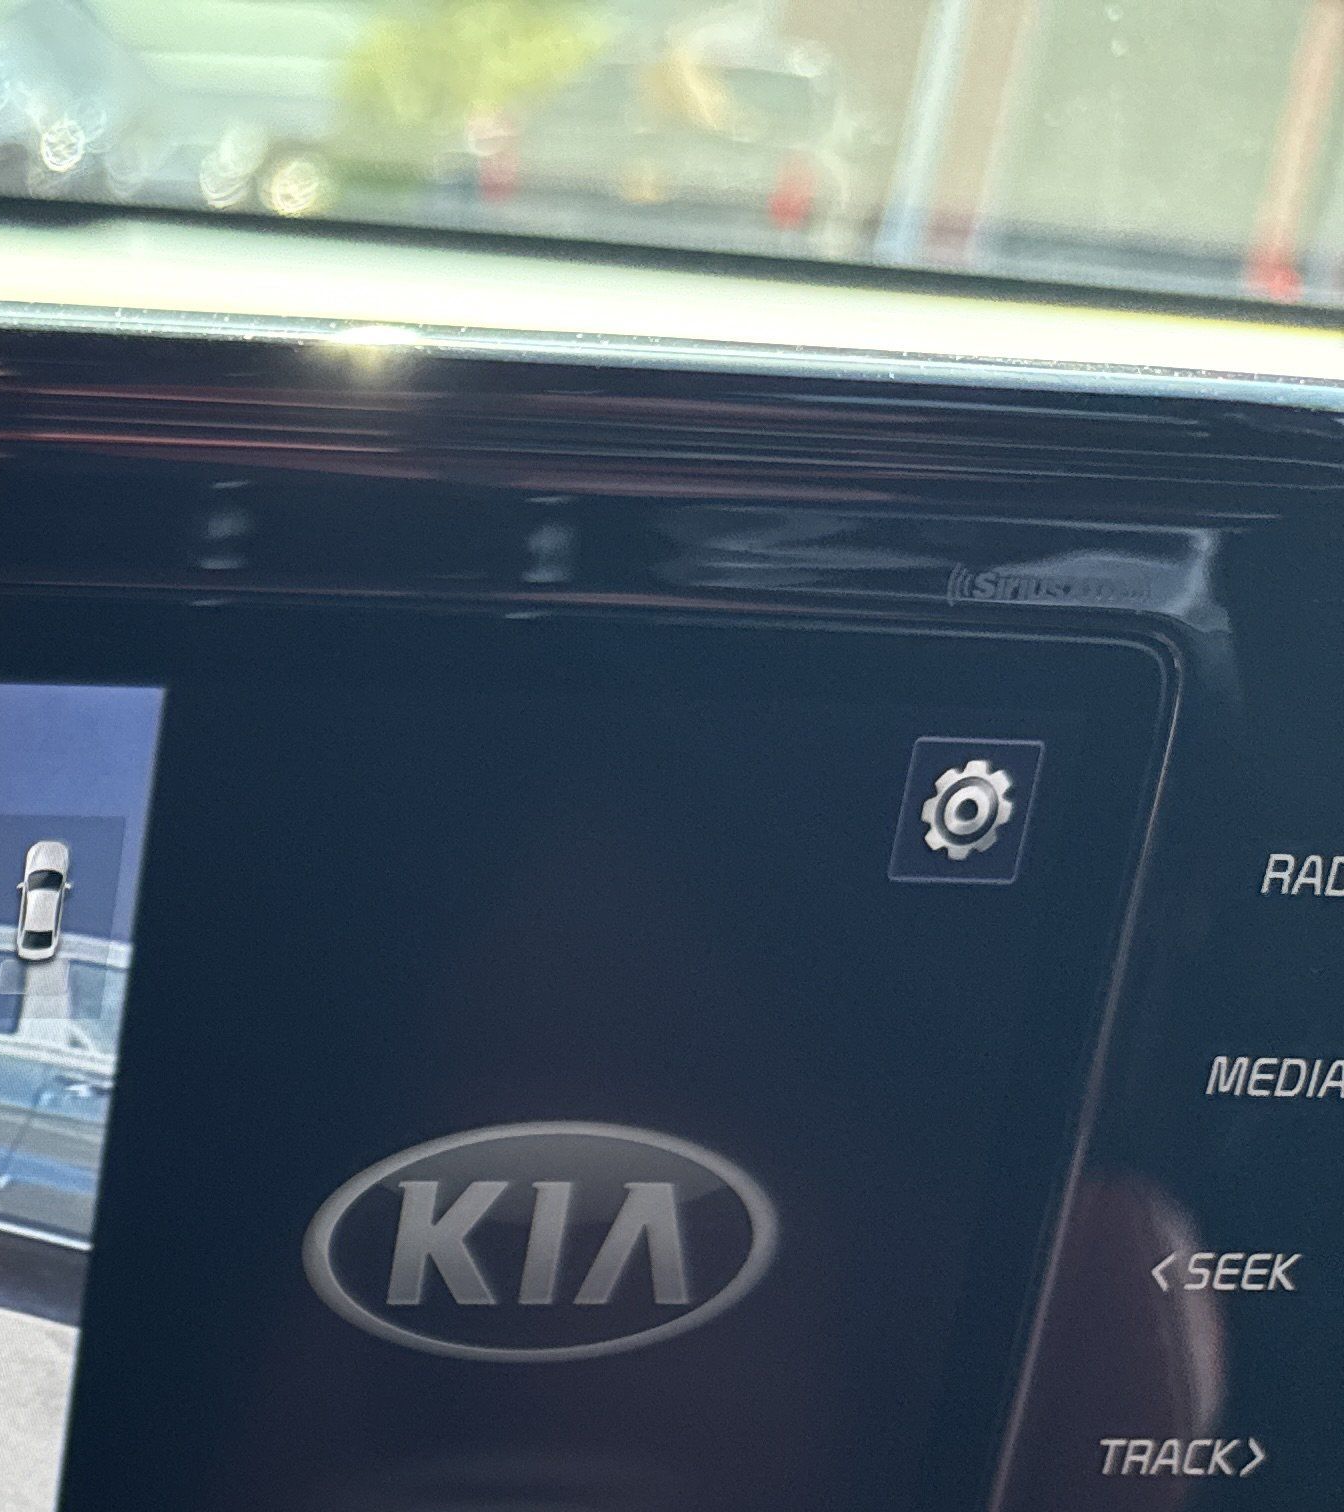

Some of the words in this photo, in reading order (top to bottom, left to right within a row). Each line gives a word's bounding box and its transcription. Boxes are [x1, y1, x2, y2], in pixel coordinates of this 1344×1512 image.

[1205, 1055, 1344, 1099] MEDIA
[386, 1180, 690, 1305] KIA
[1183, 1251, 1303, 1292] SEEK
[1100, 1438, 1242, 1476] TRACK
